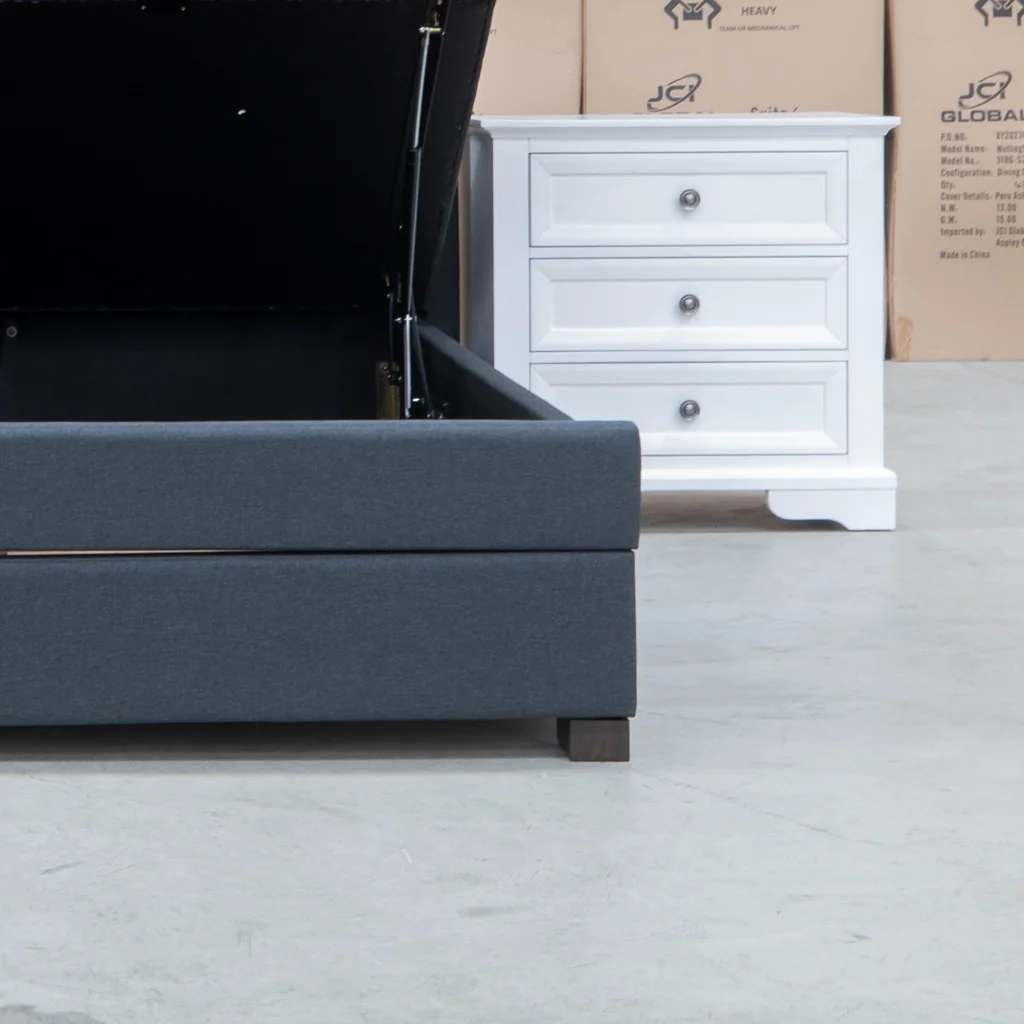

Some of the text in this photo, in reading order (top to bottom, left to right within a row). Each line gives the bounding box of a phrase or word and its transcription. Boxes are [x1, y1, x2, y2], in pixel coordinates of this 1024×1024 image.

[742, 6, 776, 16] HEAVY
[647, 84, 695, 103] JCI
[959, 82, 1006, 100] JCI
